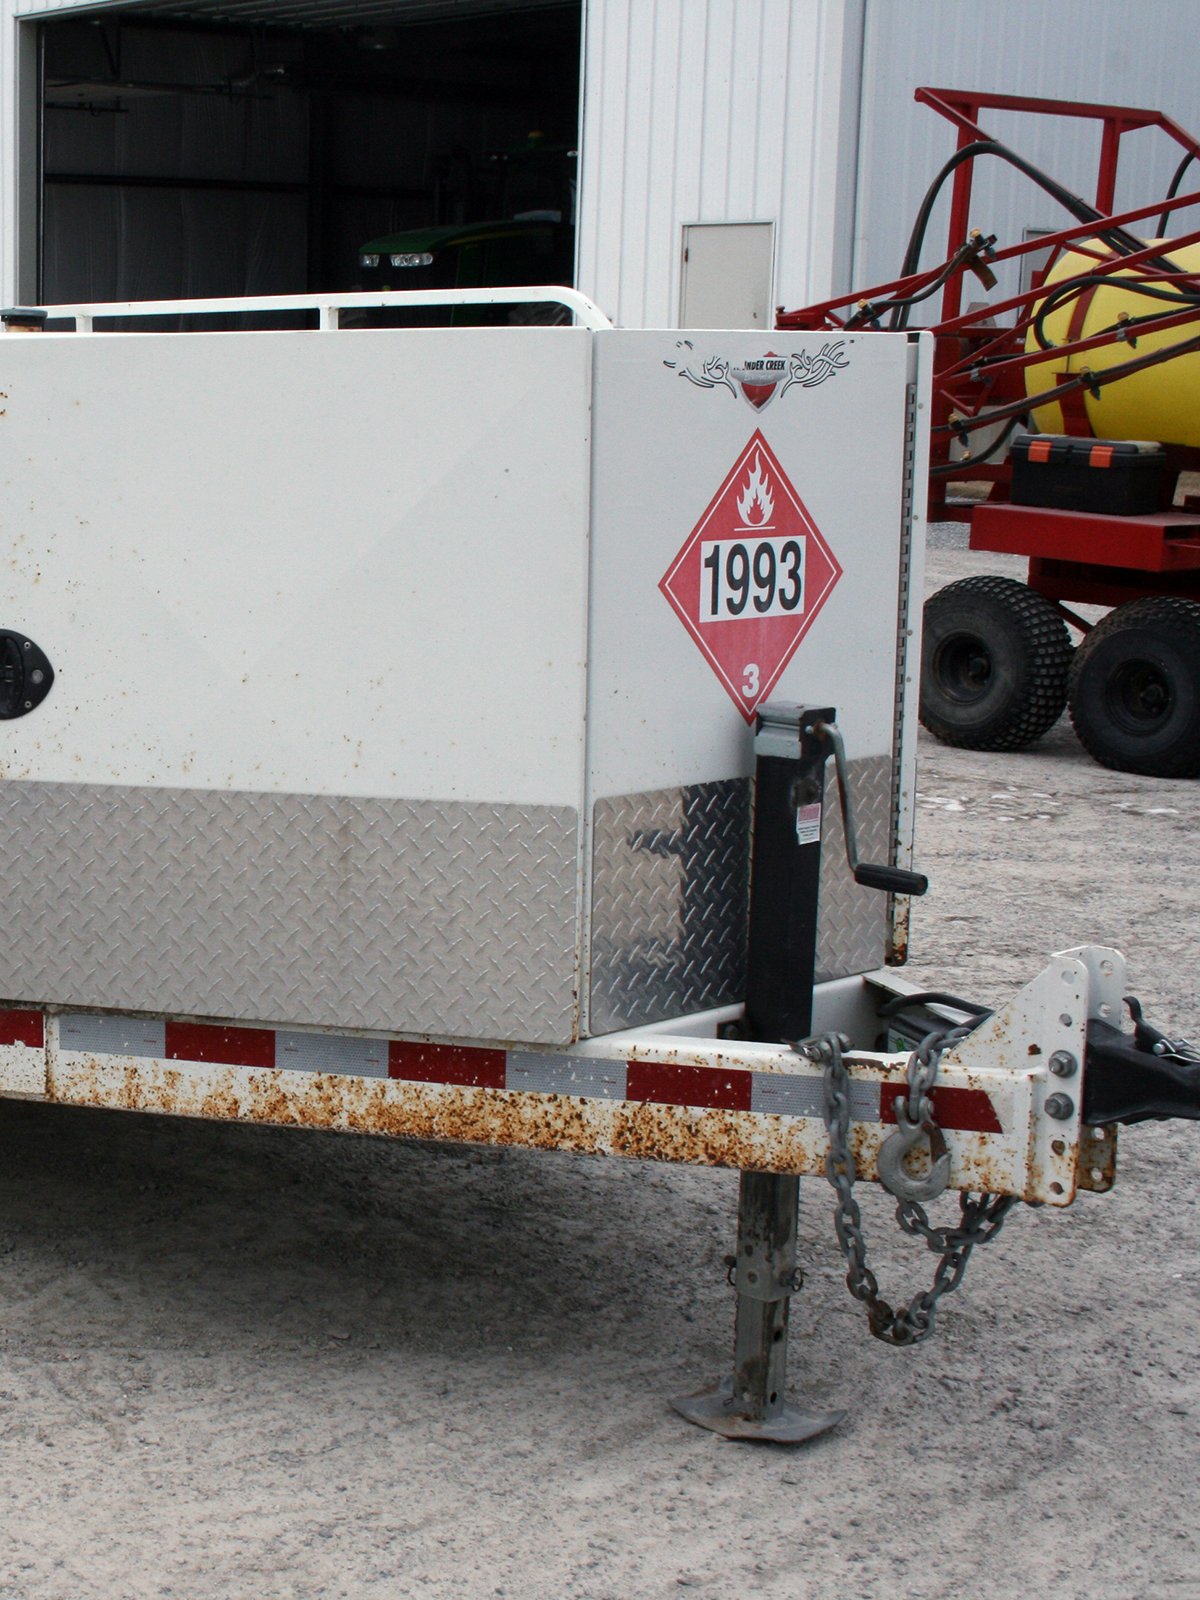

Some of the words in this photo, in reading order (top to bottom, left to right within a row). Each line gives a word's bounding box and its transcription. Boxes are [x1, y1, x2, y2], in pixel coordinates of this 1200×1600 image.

[765, 360, 787, 371] CREEK
[704, 540, 803, 616] 1993
[741, 663, 760, 698] 3
